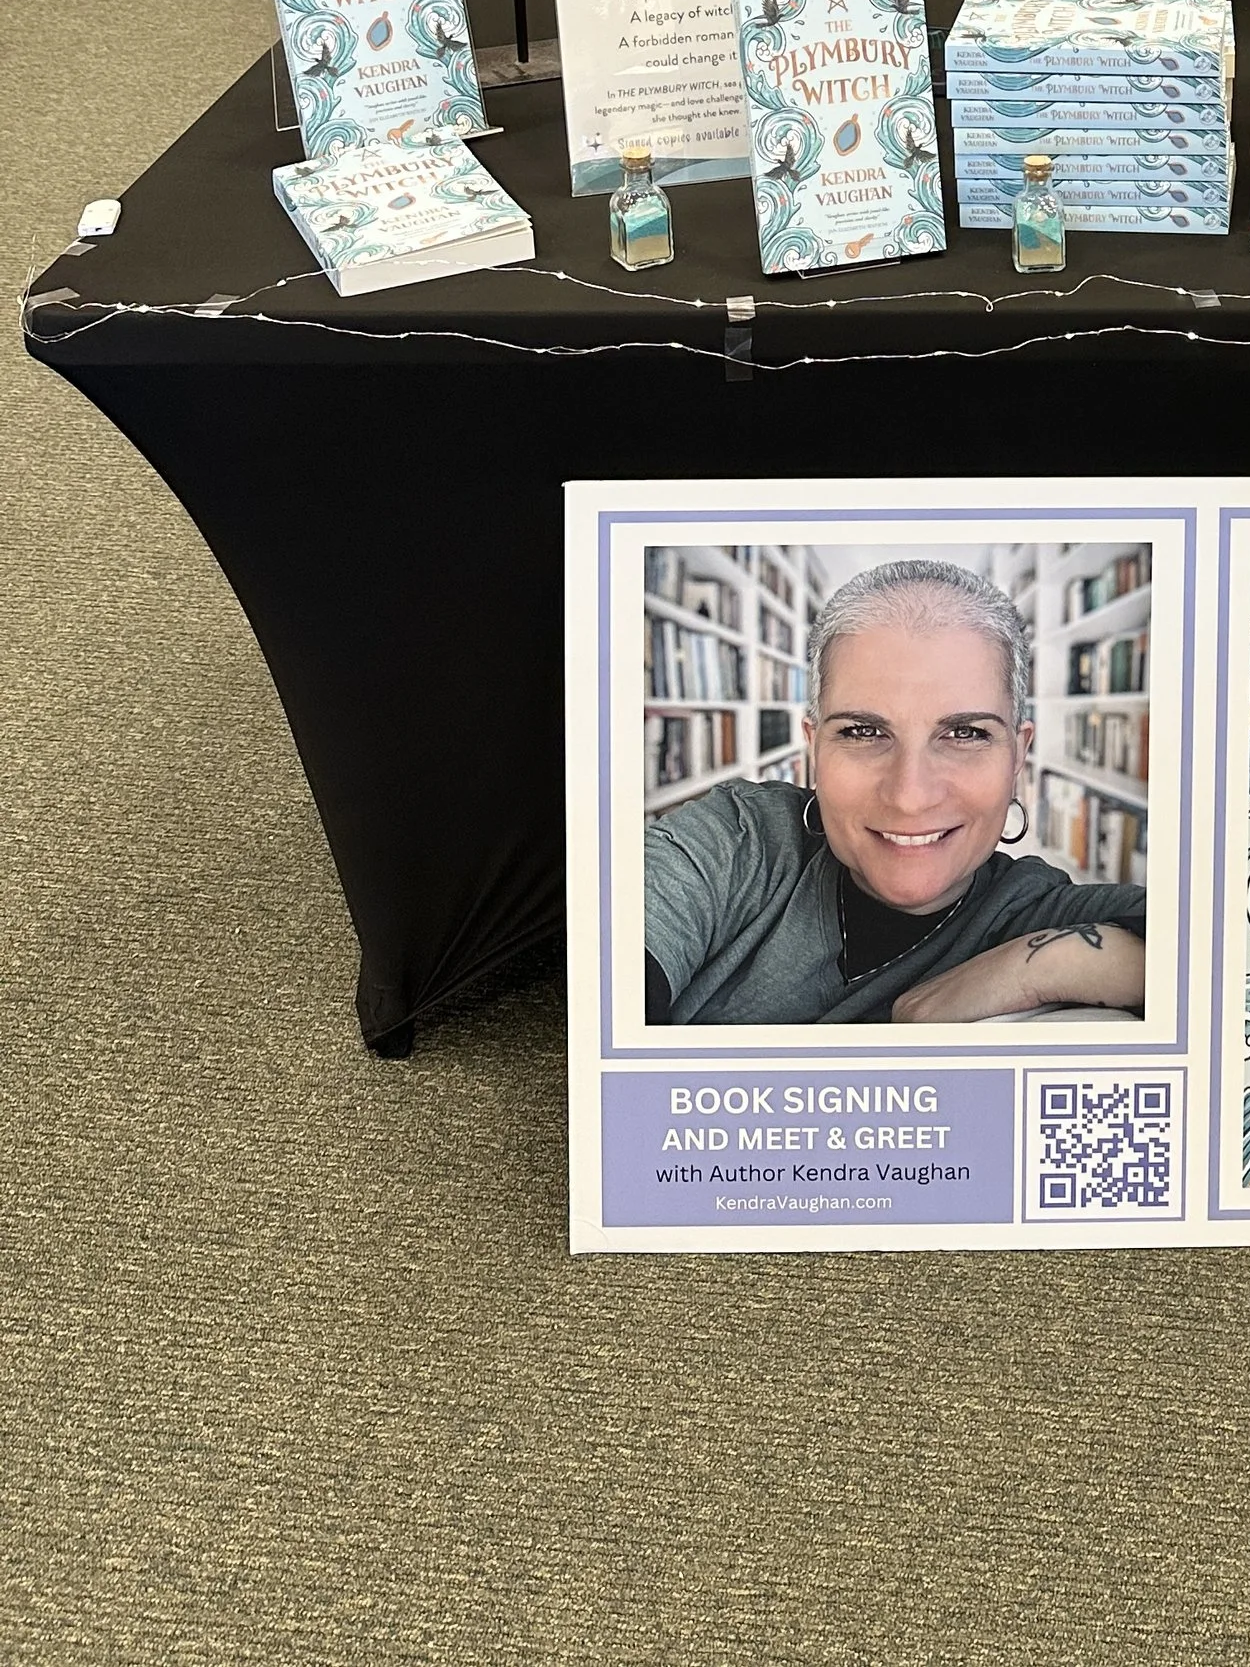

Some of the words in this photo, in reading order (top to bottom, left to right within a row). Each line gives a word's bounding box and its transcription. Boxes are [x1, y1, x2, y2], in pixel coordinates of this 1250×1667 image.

[630, 11, 642, 23] A
[645, 8, 685, 26] legacy
[688, 6, 702, 19] of
[825, 19, 853, 33] THE
[618, 39, 630, 49] A
[632, 32, 692, 48] forbidden
[695, 30, 734, 42] roman
[356, 58, 421, 80] KENDRA
[645, 53, 679, 68] could
[682, 51, 727, 67] change
[729, 51, 738, 61] it
[768, 37, 912, 87] PLYMBURY
[1043, 56, 1094, 67] PLYMBURY
[1098, 56, 1132, 67] WITCH
[354, 75, 429, 98] VAUGHAN
[607, 90, 616, 99] In
[618, 89, 636, 98] THE
[638, 83, 687, 97] PLYMBURY
[792, 74, 892, 106] WITCH
[595, 105, 636, 117] legendary
[687, 97, 704, 106] love
[652, 115, 666, 123] she
[668, 111, 701, 123] thought
[703, 109, 716, 118] she
[657, 134, 691, 147] copies
[696, 127, 740, 141] available
[820, 166, 887, 187] KENDRA
[816, 186, 893, 207] VAUGHAN
[669, 1086, 775, 1116] BOOK
[782, 1084, 939, 1115] SIGNING
[661, 1128, 729, 1152] AND
[737, 1127, 821, 1152] MEET
[826, 1127, 848, 1151] &
[853, 1125, 951, 1151] GREET
[655, 1162, 703, 1184] with
[709, 1162, 786, 1184] Author
[792, 1161, 870, 1183] Kendra
[876, 1160, 971, 1188] Vaughan
[715, 1194, 893, 1214] KendraVaughan.com
